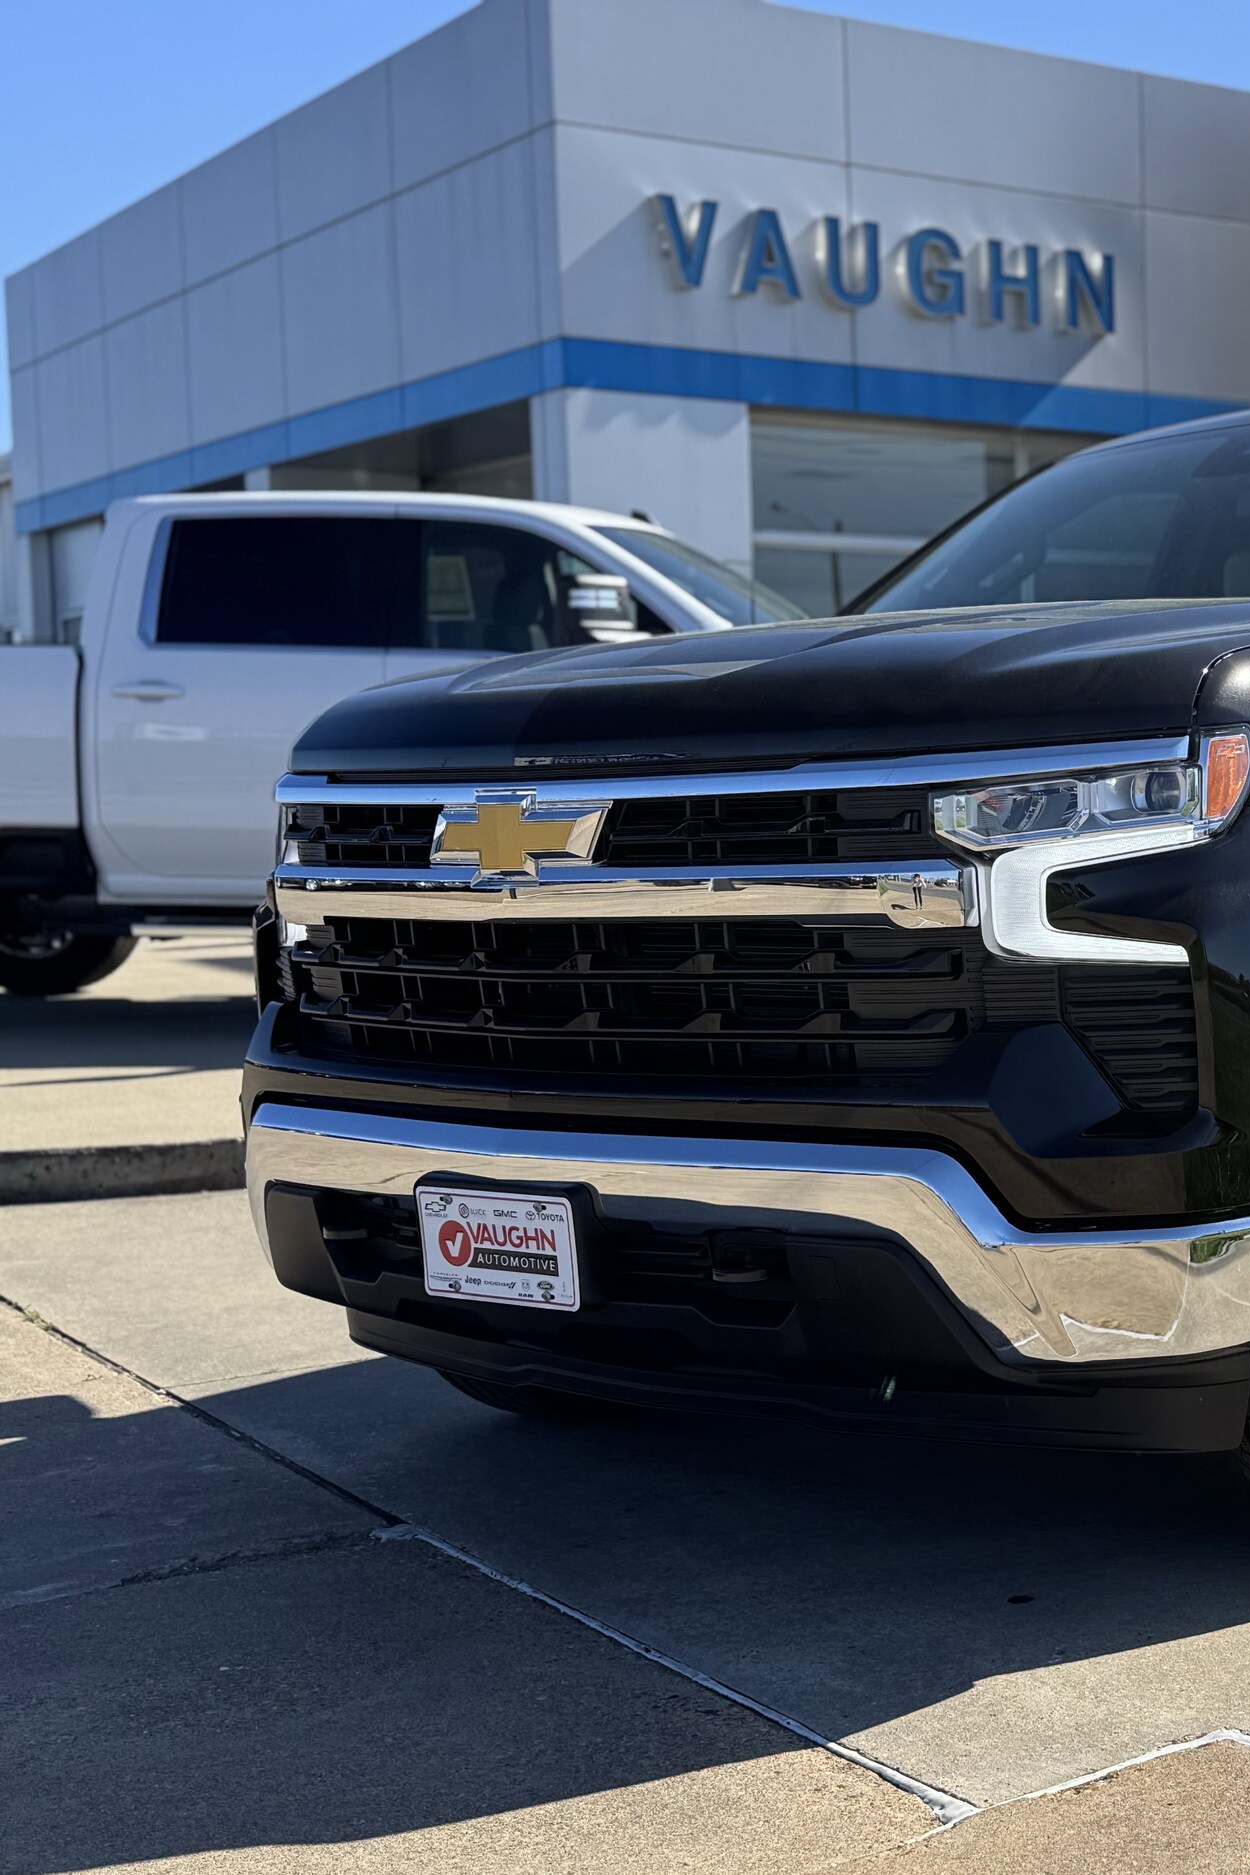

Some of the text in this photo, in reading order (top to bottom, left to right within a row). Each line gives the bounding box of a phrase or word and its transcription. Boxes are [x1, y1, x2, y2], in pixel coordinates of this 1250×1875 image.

[646, 193, 1115, 335] VAUGHN
[493, 1209, 518, 1218] GMC
[537, 1212, 565, 1223] TOYOTA
[466, 1221, 557, 1252] VAUGHN
[477, 1252, 556, 1271] AUTOMOTIVE
[465, 1276, 482, 1286] Jeep
